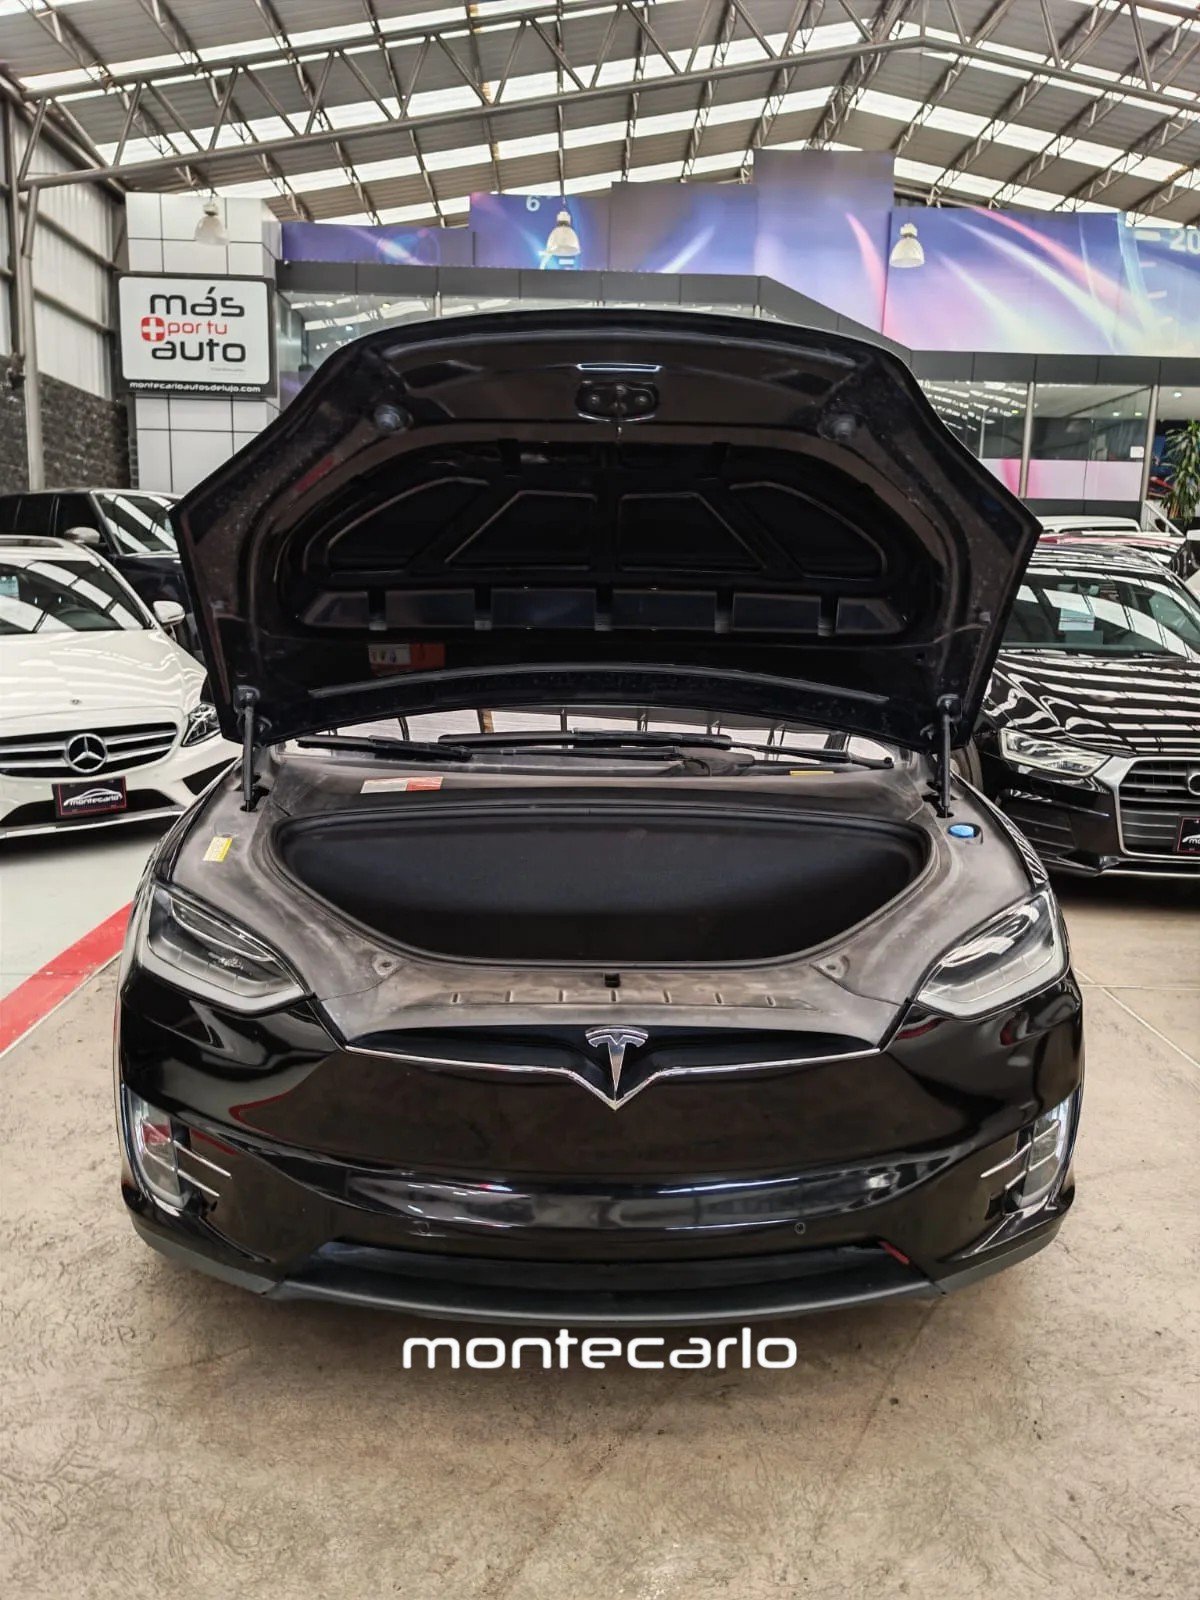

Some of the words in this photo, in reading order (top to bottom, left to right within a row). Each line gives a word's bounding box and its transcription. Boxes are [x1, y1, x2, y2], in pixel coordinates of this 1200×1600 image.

[150, 286, 245, 318] más
[167, 321, 202, 336] por
[207, 320, 228, 335] tu
[151, 338, 246, 363] auto
[129, 381, 261, 393] montecarloautosdelujo.com
